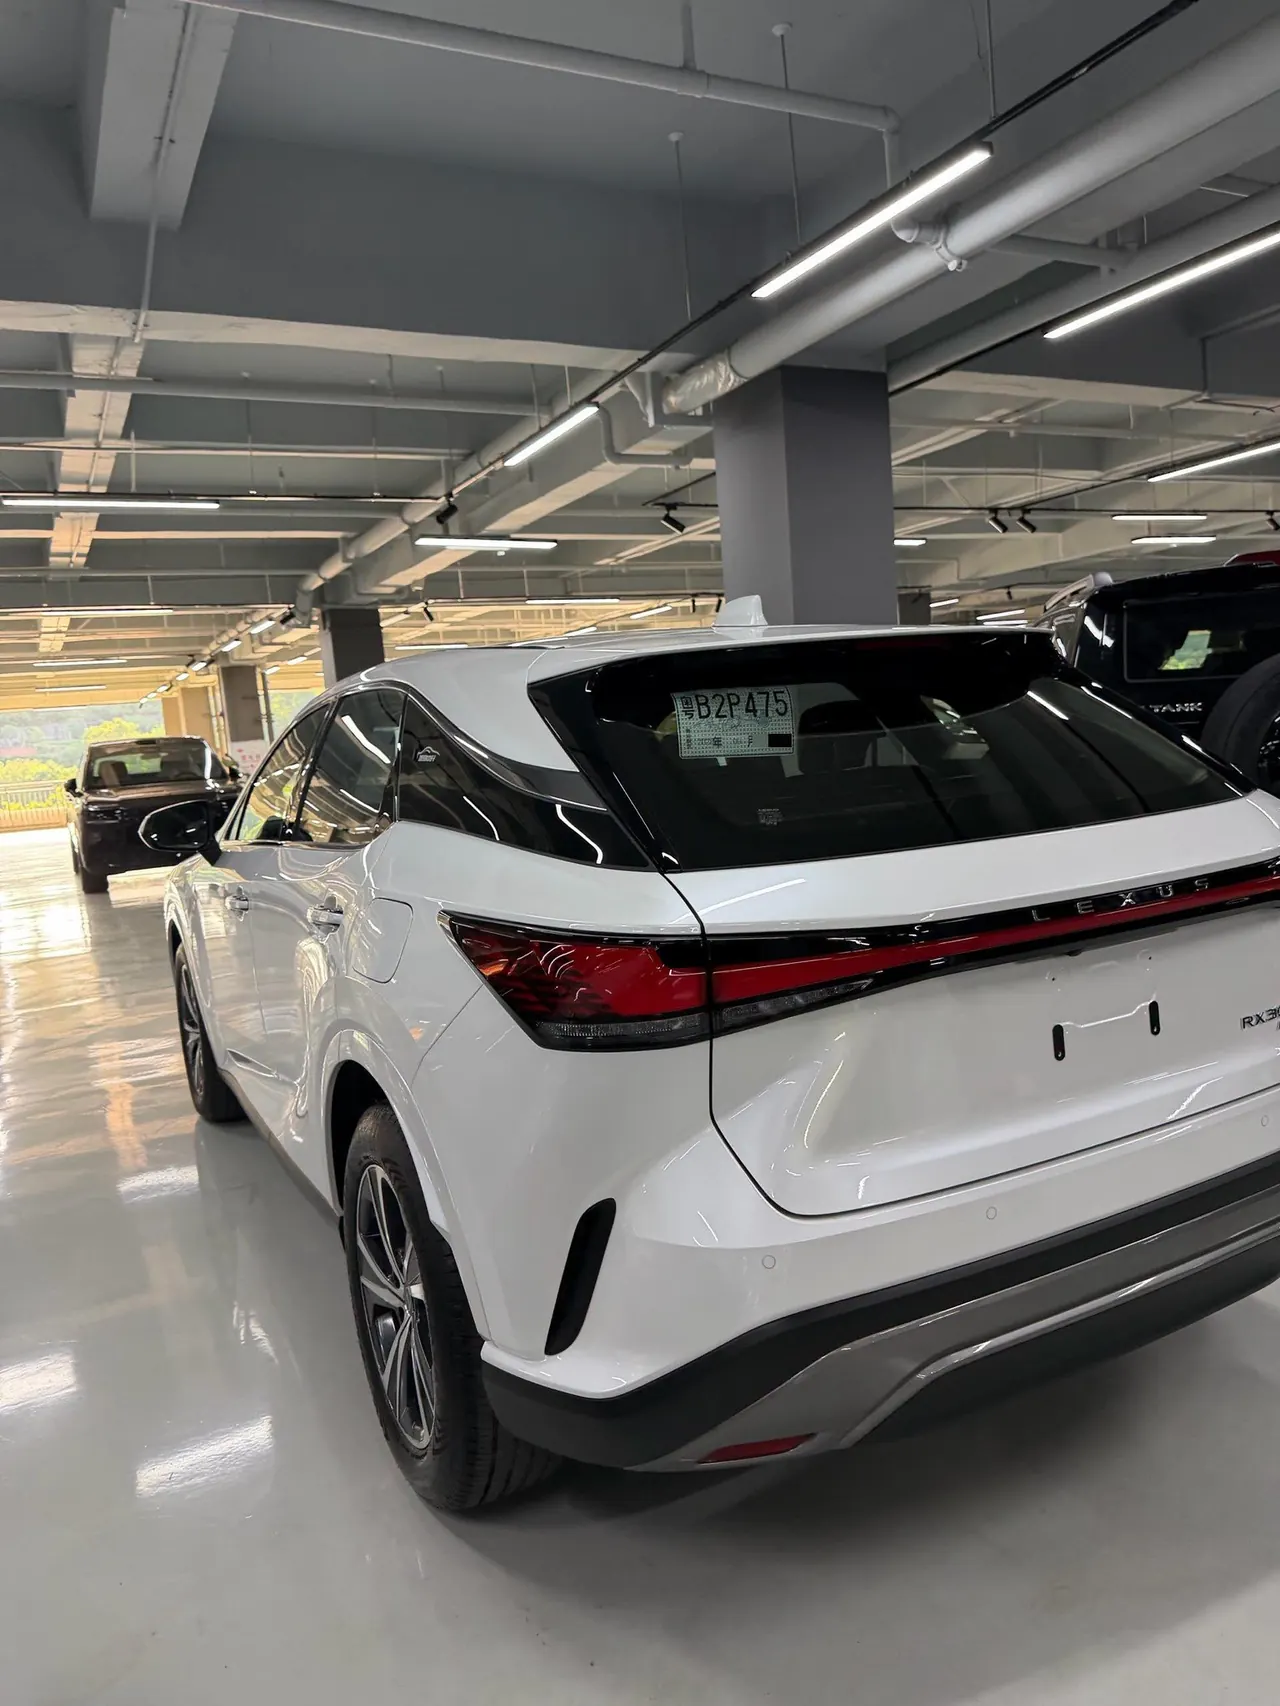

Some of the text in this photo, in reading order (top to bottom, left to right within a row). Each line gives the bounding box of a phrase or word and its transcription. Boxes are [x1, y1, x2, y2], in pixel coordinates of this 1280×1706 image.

[1149, 702, 1202, 712] TANK
[1032, 878, 1209, 922] LEXUS
[1240, 1005, 1280, 1031] RX3
